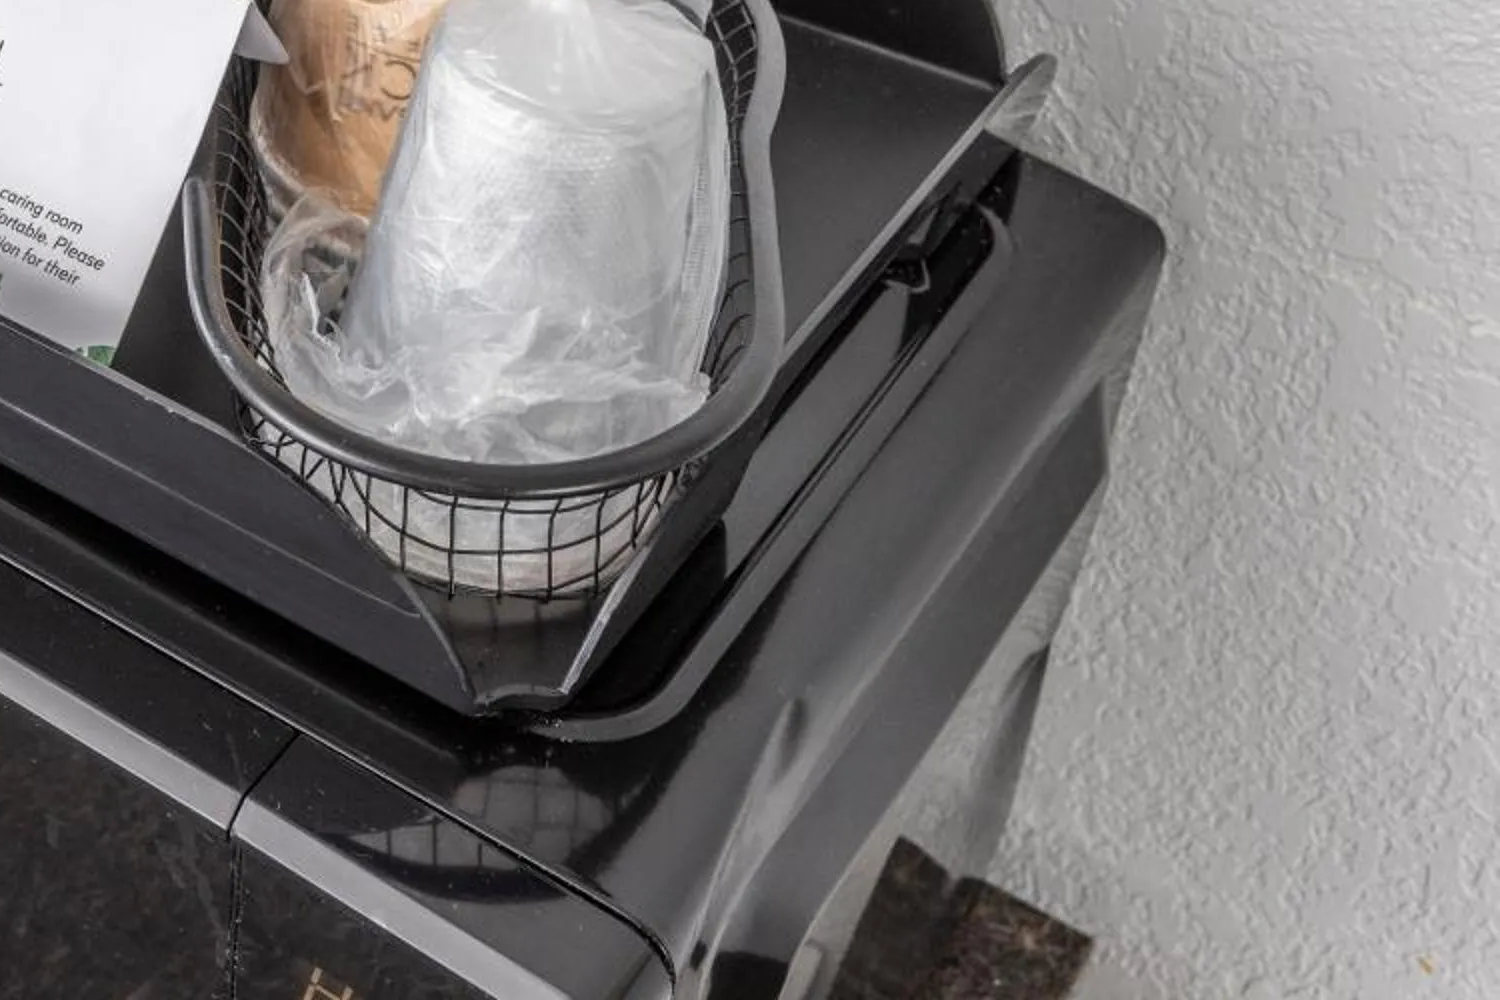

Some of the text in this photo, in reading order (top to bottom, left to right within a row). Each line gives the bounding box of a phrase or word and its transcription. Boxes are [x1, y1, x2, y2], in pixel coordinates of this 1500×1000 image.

[0, 185, 44, 219] caring
[45, 211, 83, 235] room
[22, 249, 43, 268] for
[43, 259, 81, 286] their
[52, 235, 105, 271] Please
